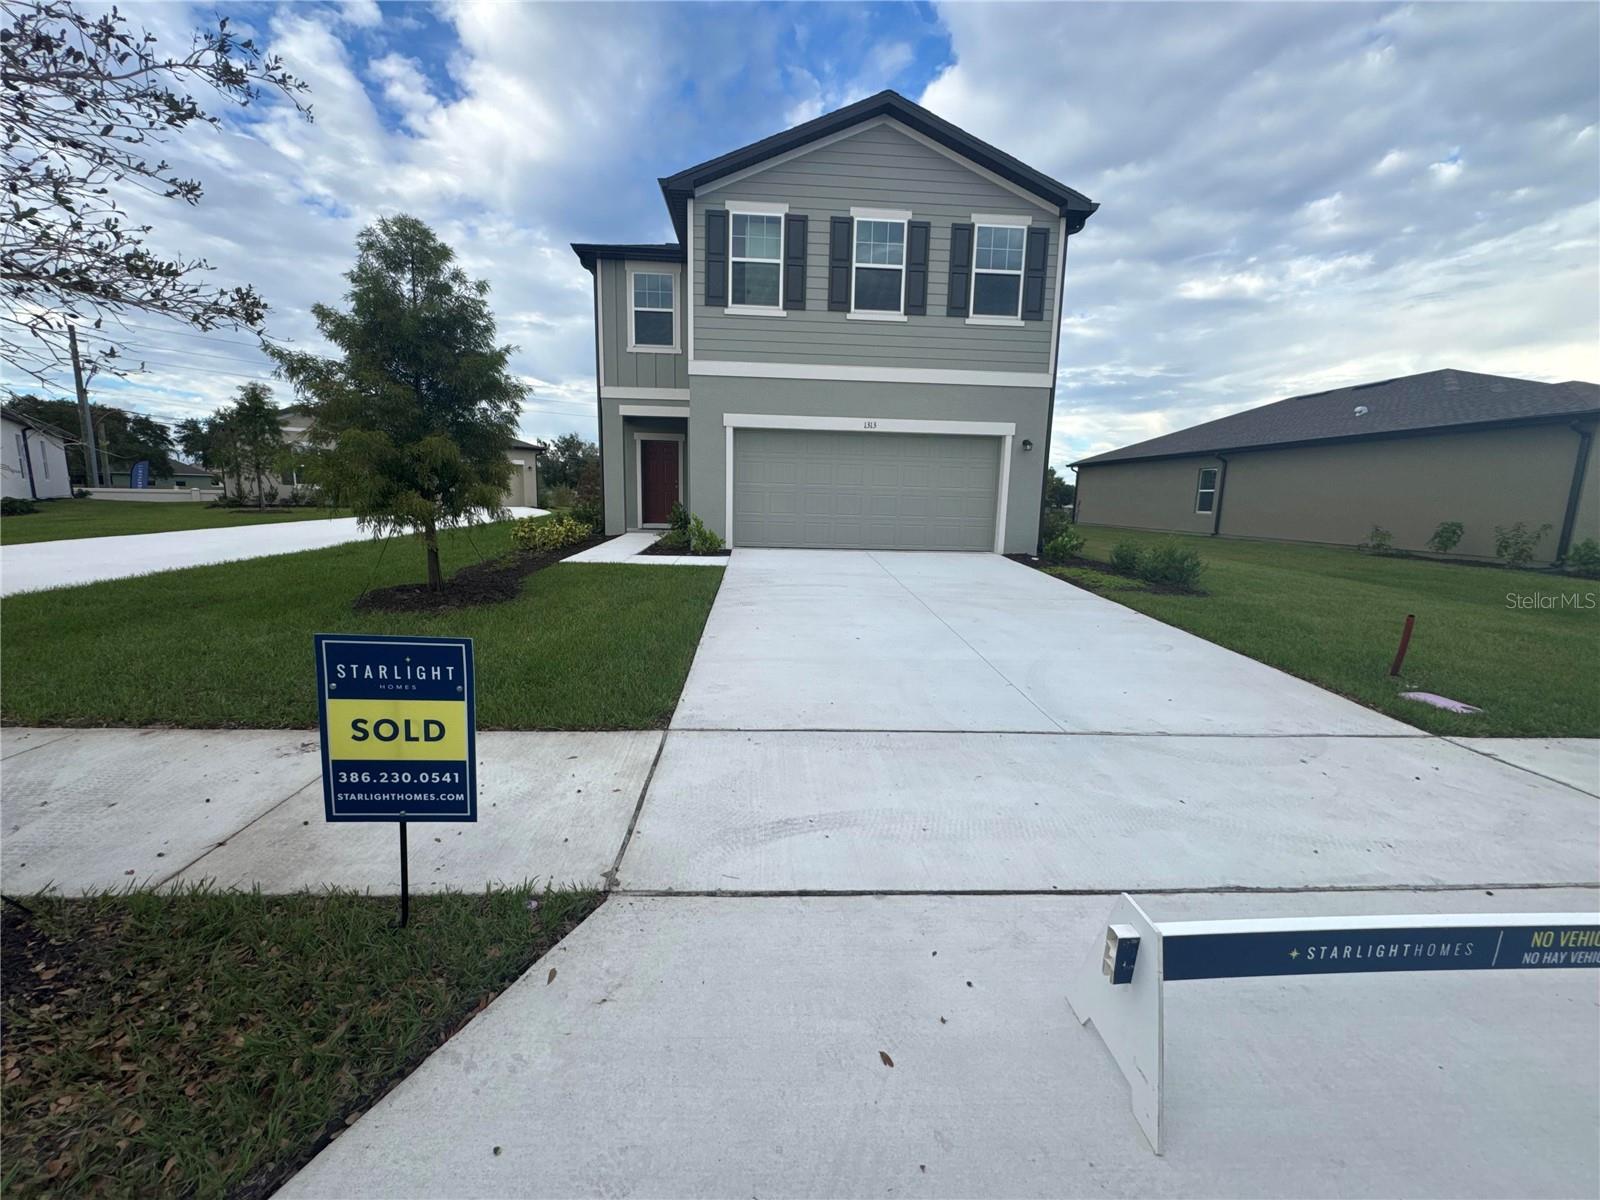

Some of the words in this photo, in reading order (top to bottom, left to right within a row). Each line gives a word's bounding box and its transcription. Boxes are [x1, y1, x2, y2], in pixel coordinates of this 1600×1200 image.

[864, 421, 877, 429] 1313
[336, 663, 455, 681] STARLIGHT
[350, 718, 446, 742] SOLD
[338, 772, 460, 783] 386.230.0541
[337, 792, 465, 801] STARLIGHTHOMES.COM
[1531, 930, 1555, 948] NO
[1522, 951, 1540, 965] NO
[1542, 951, 1568, 964] HAY
